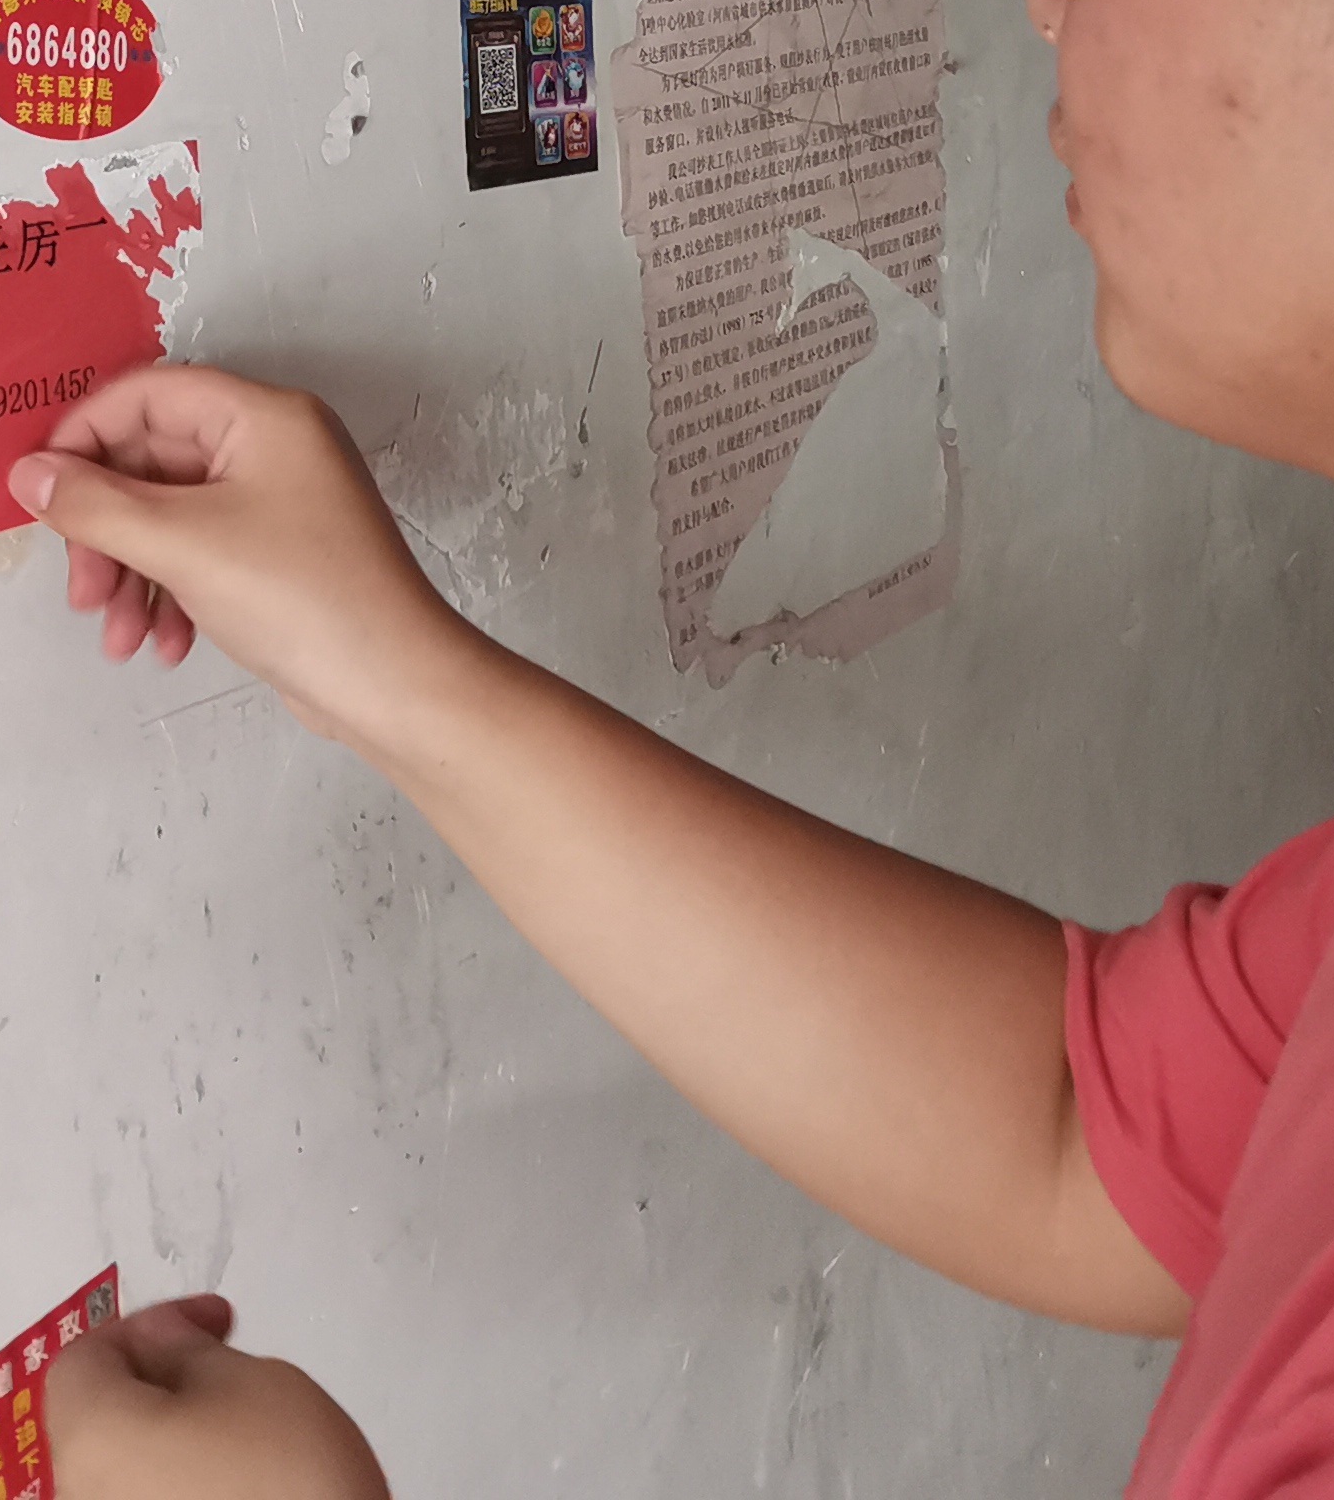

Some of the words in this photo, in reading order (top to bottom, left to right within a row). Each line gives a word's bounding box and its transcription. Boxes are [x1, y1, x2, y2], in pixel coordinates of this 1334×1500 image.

[7, 21, 128, 72] 6864880
[16, 72, 113, 101] 汽车配钥匙
[15, 101, 112, 127] 安装指纹锁
